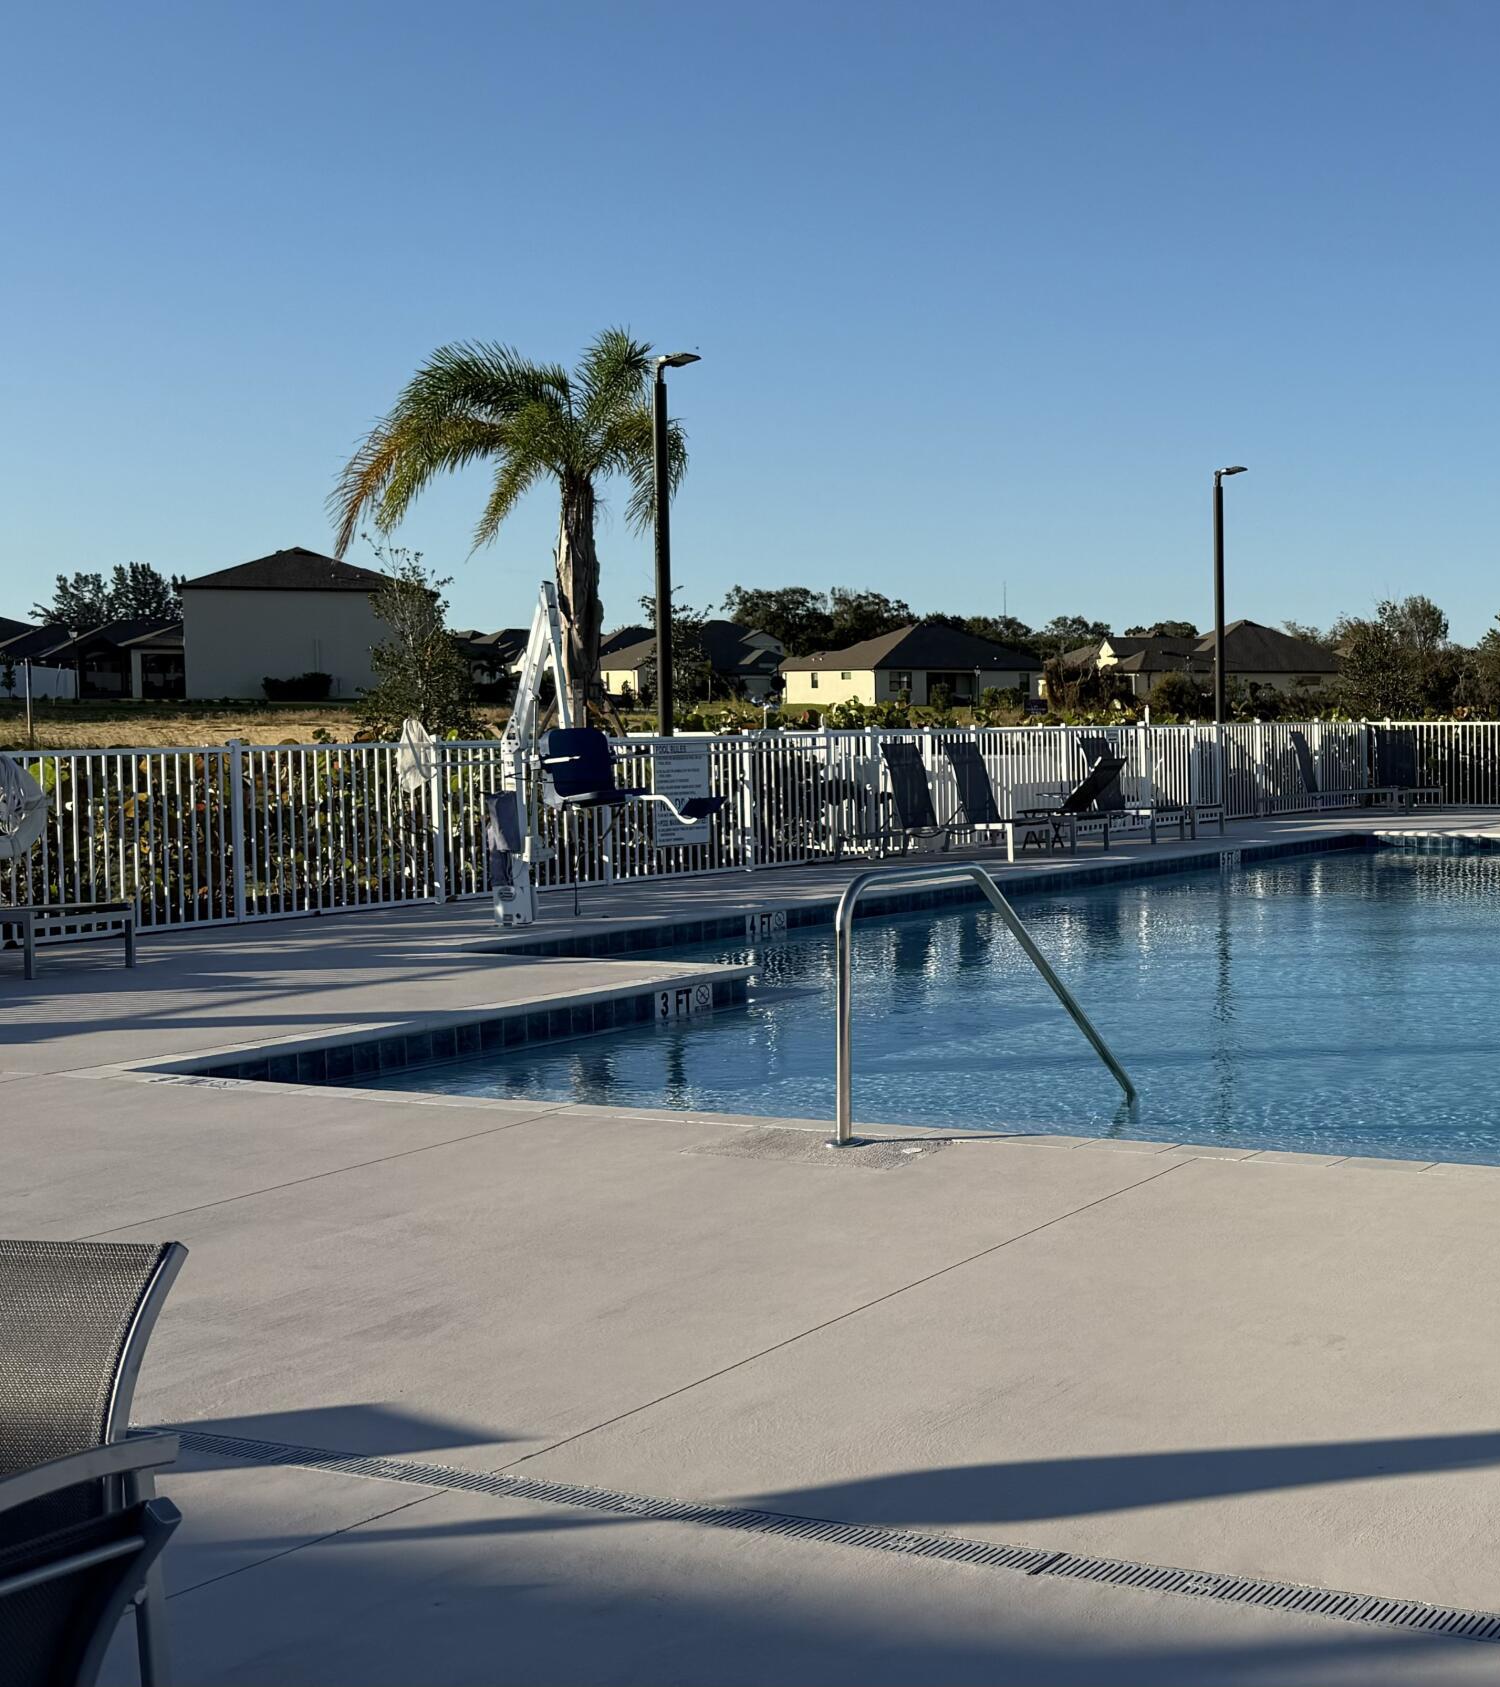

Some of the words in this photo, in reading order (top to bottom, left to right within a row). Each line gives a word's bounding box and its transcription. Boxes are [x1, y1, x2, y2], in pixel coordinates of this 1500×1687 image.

[750, 915, 757, 935] 4
[761, 913, 772, 936] FT
[661, 992, 669, 1018] 3
[676, 988, 692, 1016] FT
